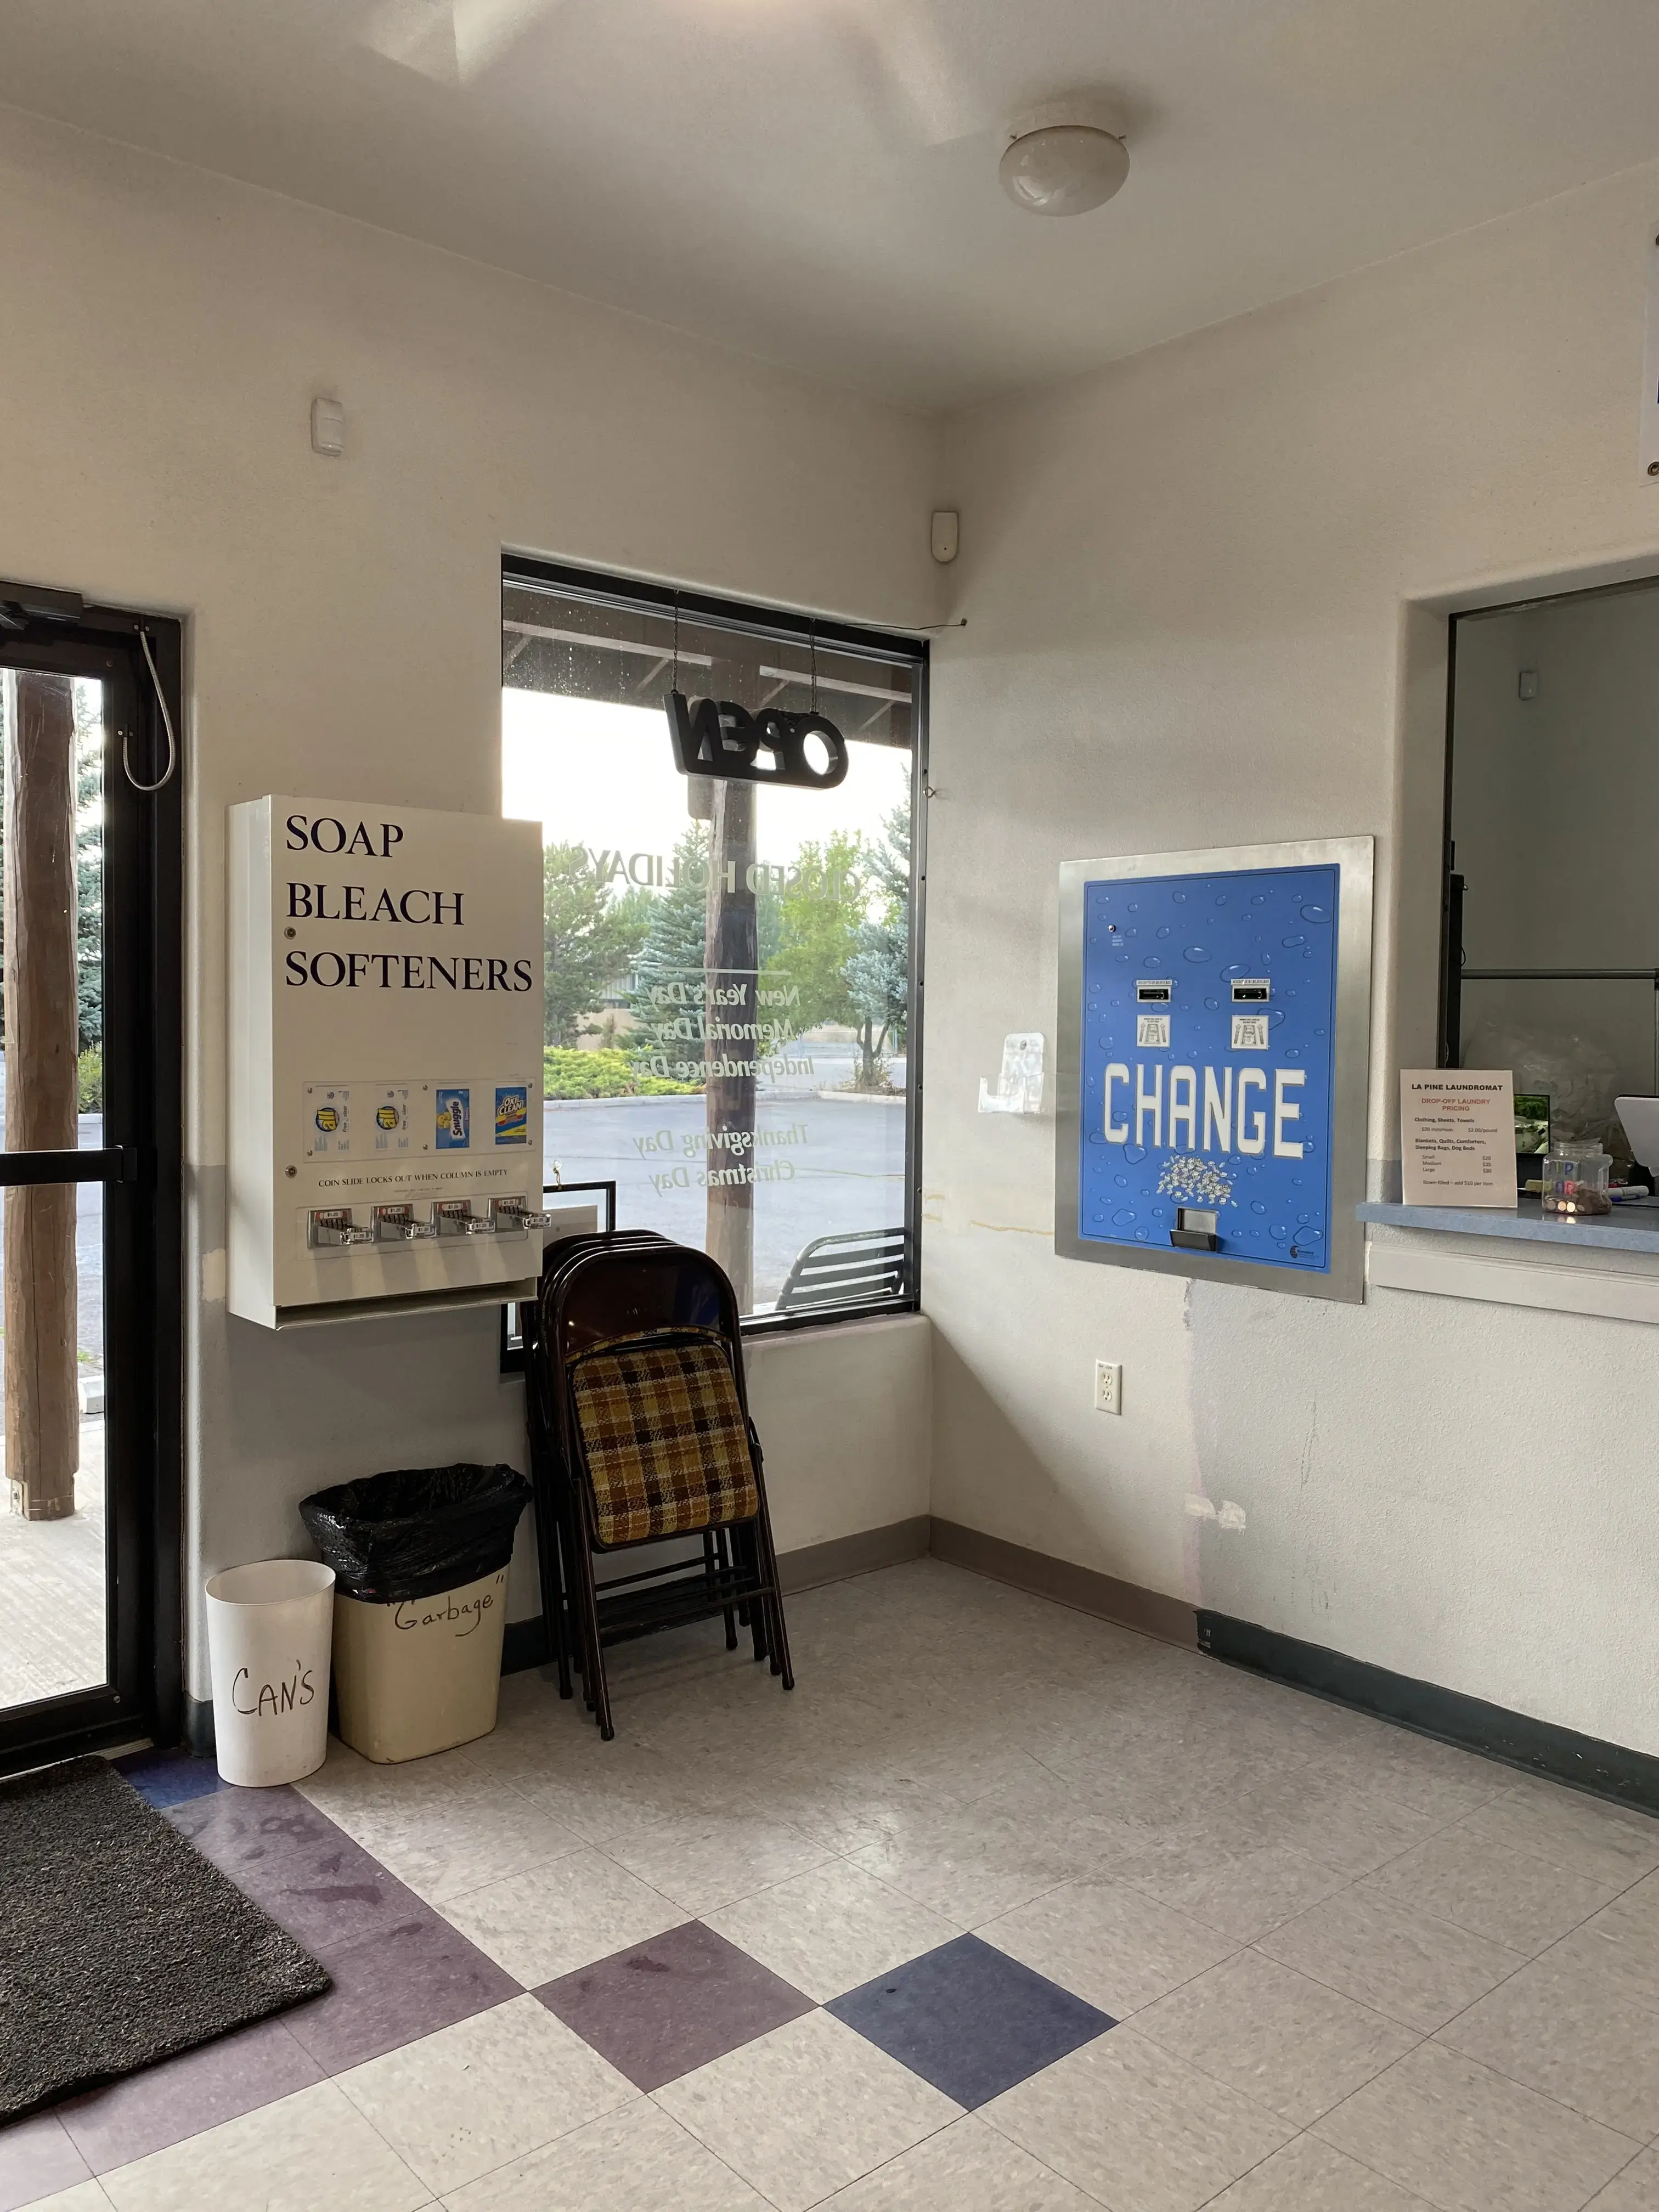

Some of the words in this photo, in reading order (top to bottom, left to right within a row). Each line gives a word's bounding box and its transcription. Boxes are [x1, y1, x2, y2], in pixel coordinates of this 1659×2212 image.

[286, 815, 403, 857] SOAP
[286, 882, 465, 926] BLEACH
[285, 950, 533, 992] SOFTENERS
[377, 1108, 398, 1129] all
[450, 1101, 462, 1136] Snuggle
[499, 1102, 522, 1115] CLEAN
[504, 1097, 518, 1107] OXI
[1103, 1063, 1306, 1159] CHANGE
[317, 1109, 337, 1131] all
[366, 1176, 393, 1184] LOCKS
[440, 1171, 473, 1180] COLUMN
[484, 1169, 509, 1177] EMPTY
[232, 1659, 315, 1717] CAN'S
